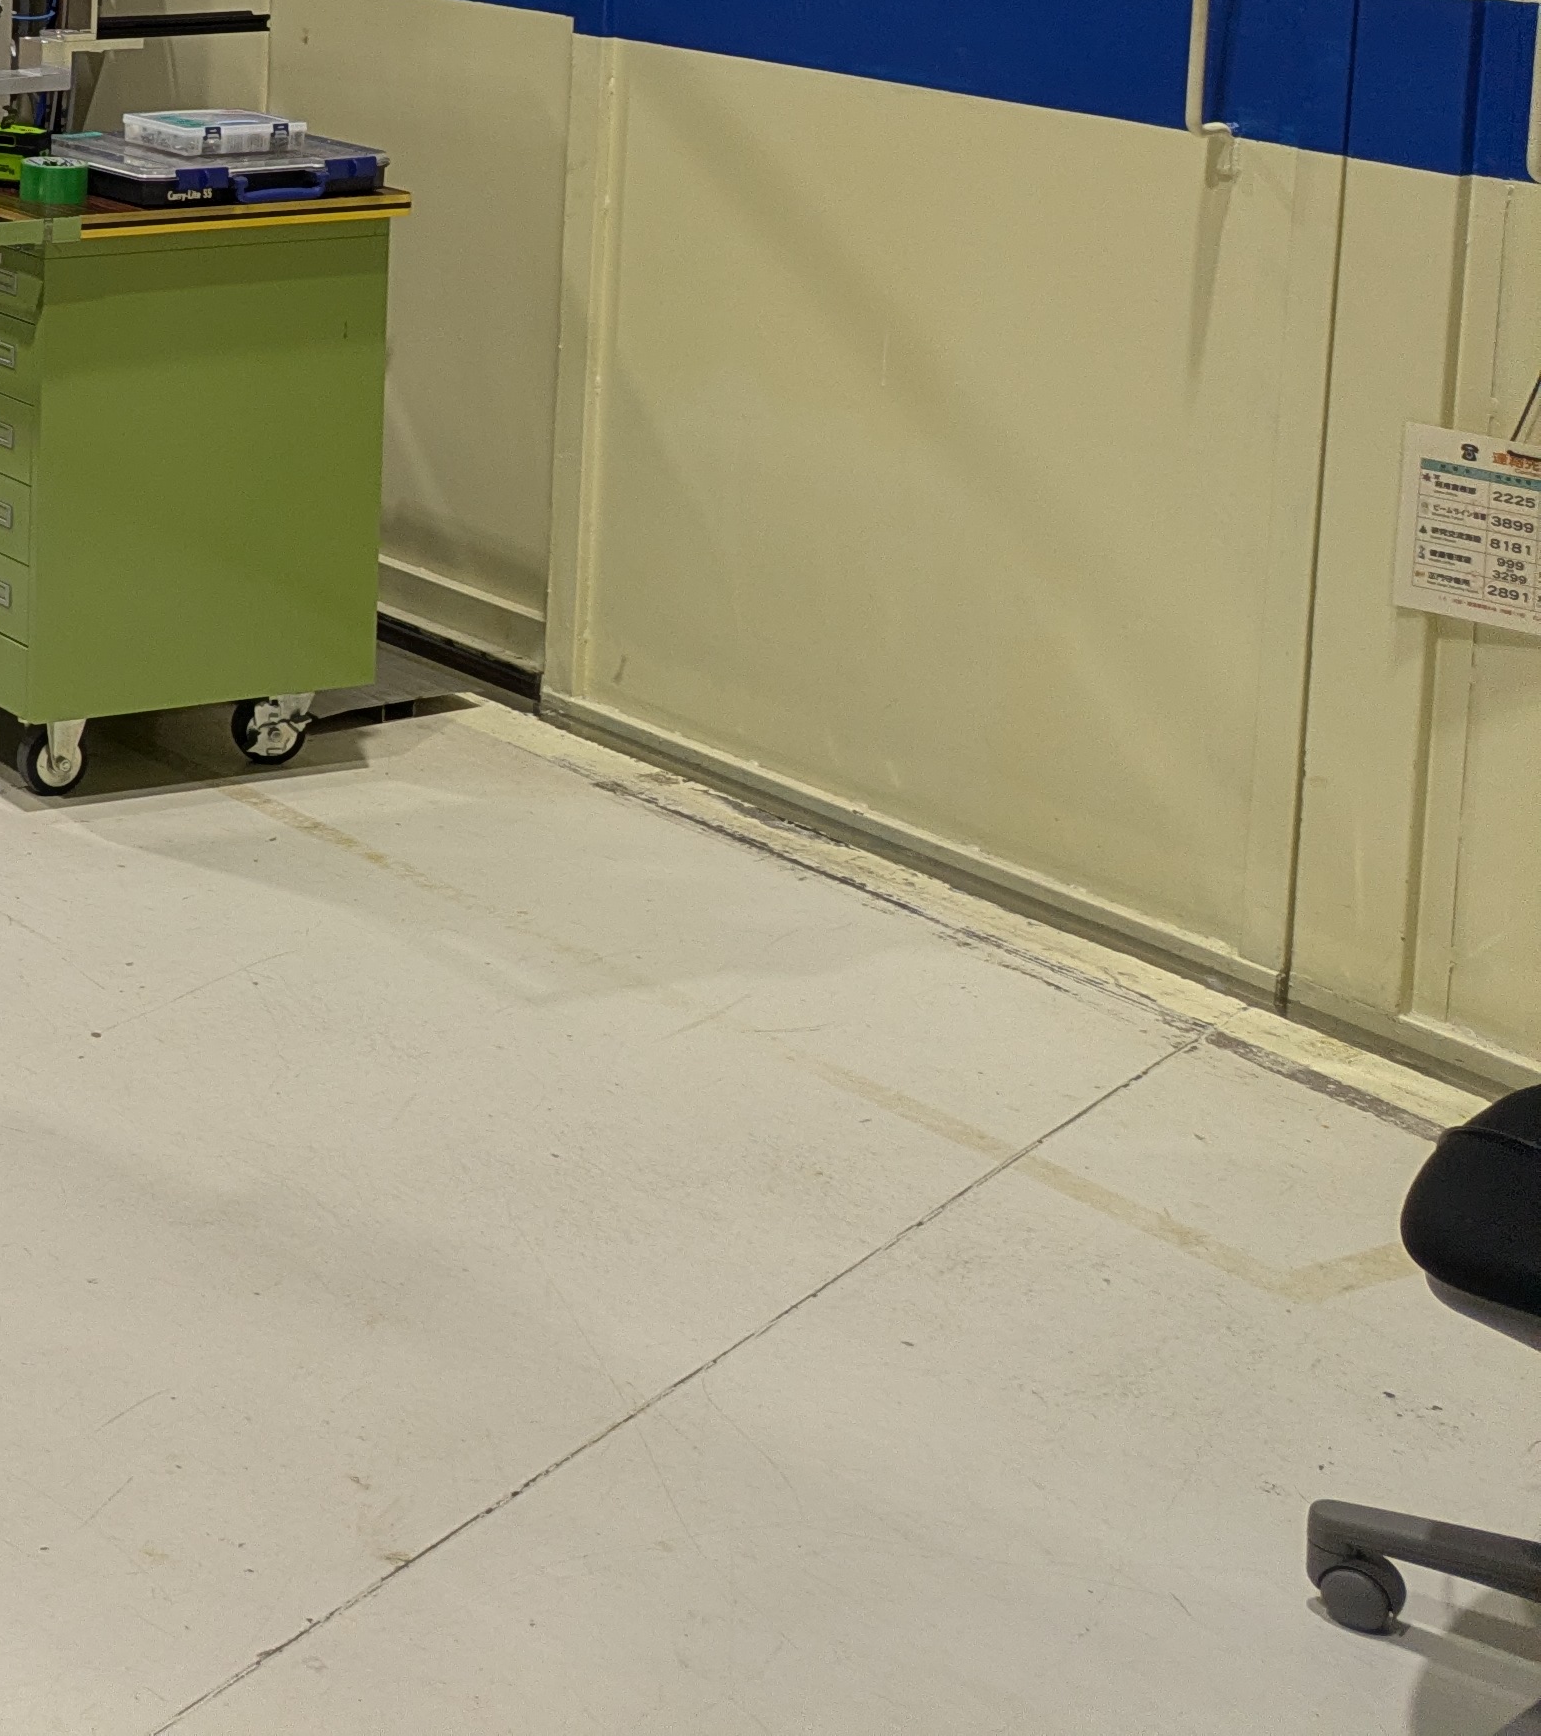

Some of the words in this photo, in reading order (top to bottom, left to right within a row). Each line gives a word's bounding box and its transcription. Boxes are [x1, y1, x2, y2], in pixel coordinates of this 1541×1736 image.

[1492, 490, 1536, 509] 2225
[1490, 515, 1534, 534] 3899
[1490, 538, 1532, 556] 8181
[1496, 557, 1525, 571] 999
[1492, 569, 1528, 585] 3299
[1487, 584, 1529, 604] 2891
